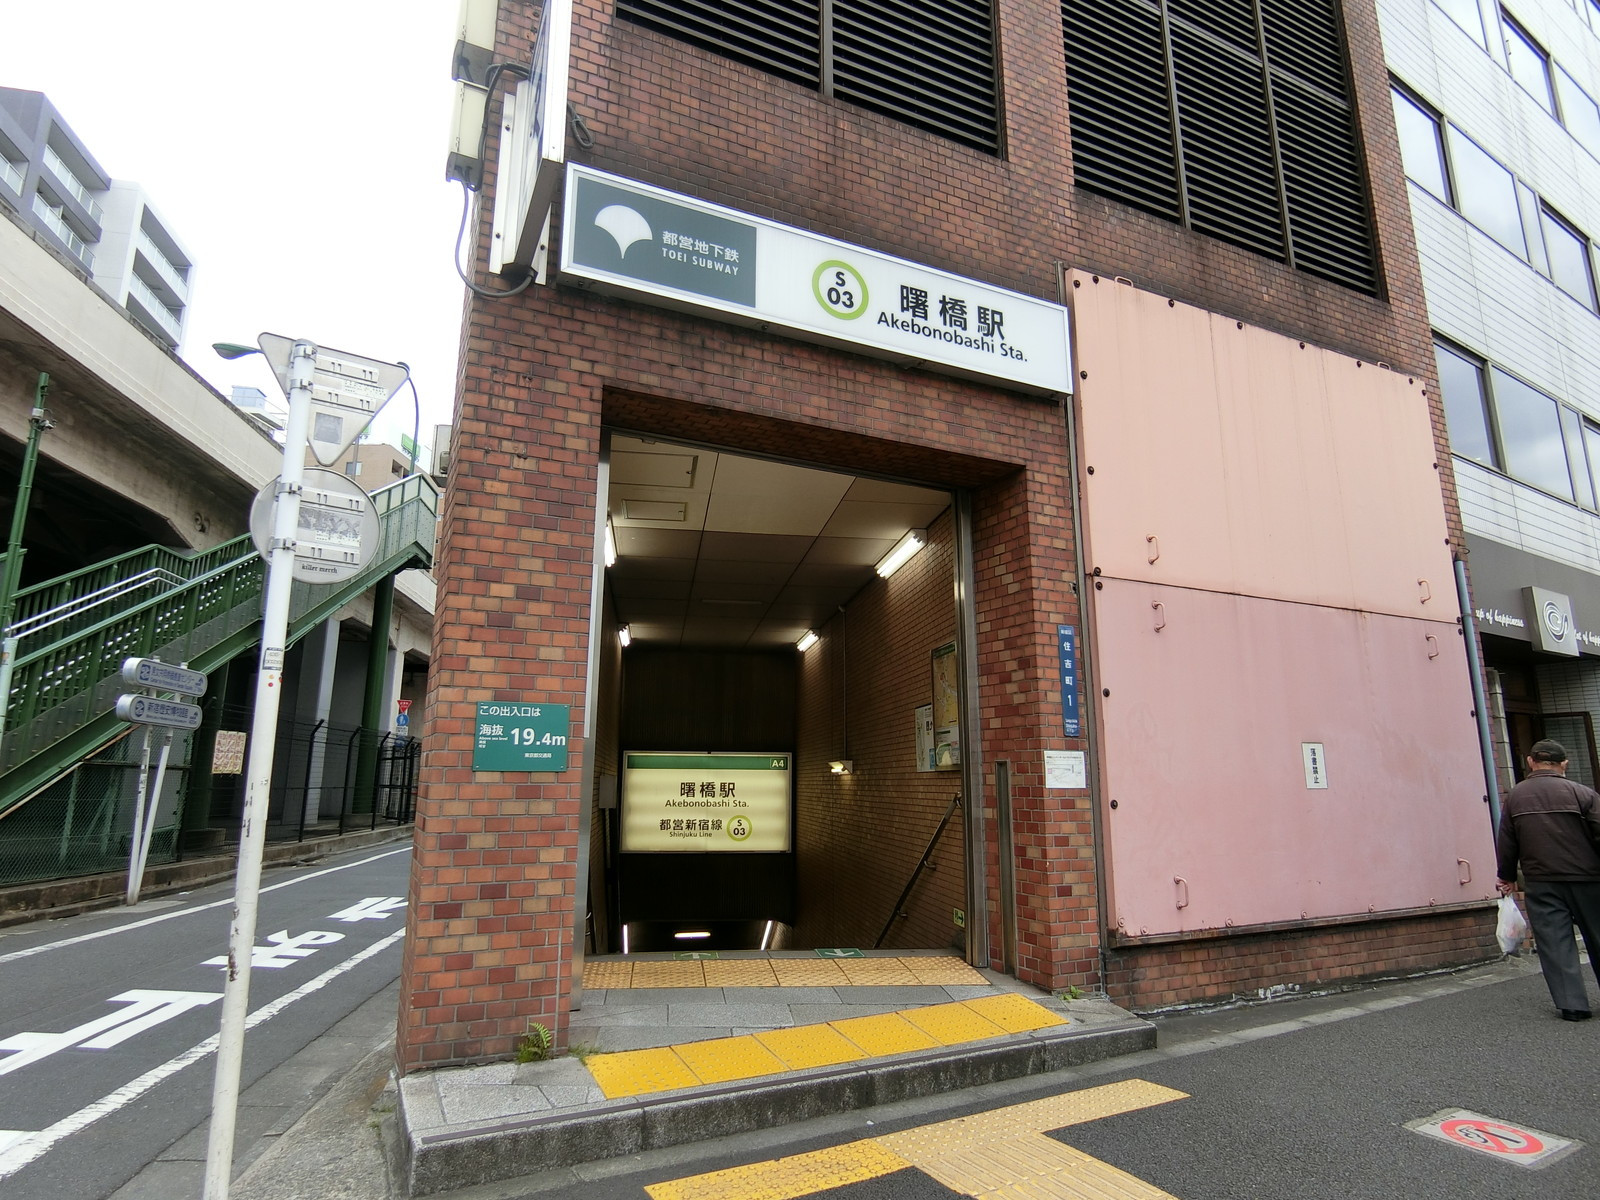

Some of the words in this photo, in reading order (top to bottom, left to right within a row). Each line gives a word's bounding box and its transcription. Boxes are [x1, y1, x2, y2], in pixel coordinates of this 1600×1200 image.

[661, 230, 740, 264] 都営地下鉄
[661, 247, 689, 265] TOEI
[692, 254, 740, 277] SUBWAY
[835, 271, 846, 287] S
[827, 286, 855, 309] 03
[899, 284, 1006, 340] 曙橋駅
[876, 311, 996, 354] Akebonobashi
[1000, 343, 1029, 364] Sta.
[479, 705, 542, 717] この出入口は
[479, 724, 504, 736] 海抜
[510, 728, 566, 746] 19.4m
[680, 782, 736, 798] 曙橋駅
[664, 799, 730, 808] Akebonobashi
[732, 799, 750, 808] Sta.
[658, 818, 723, 831] 都営新宿線
[733, 827, 746, 836] 03
